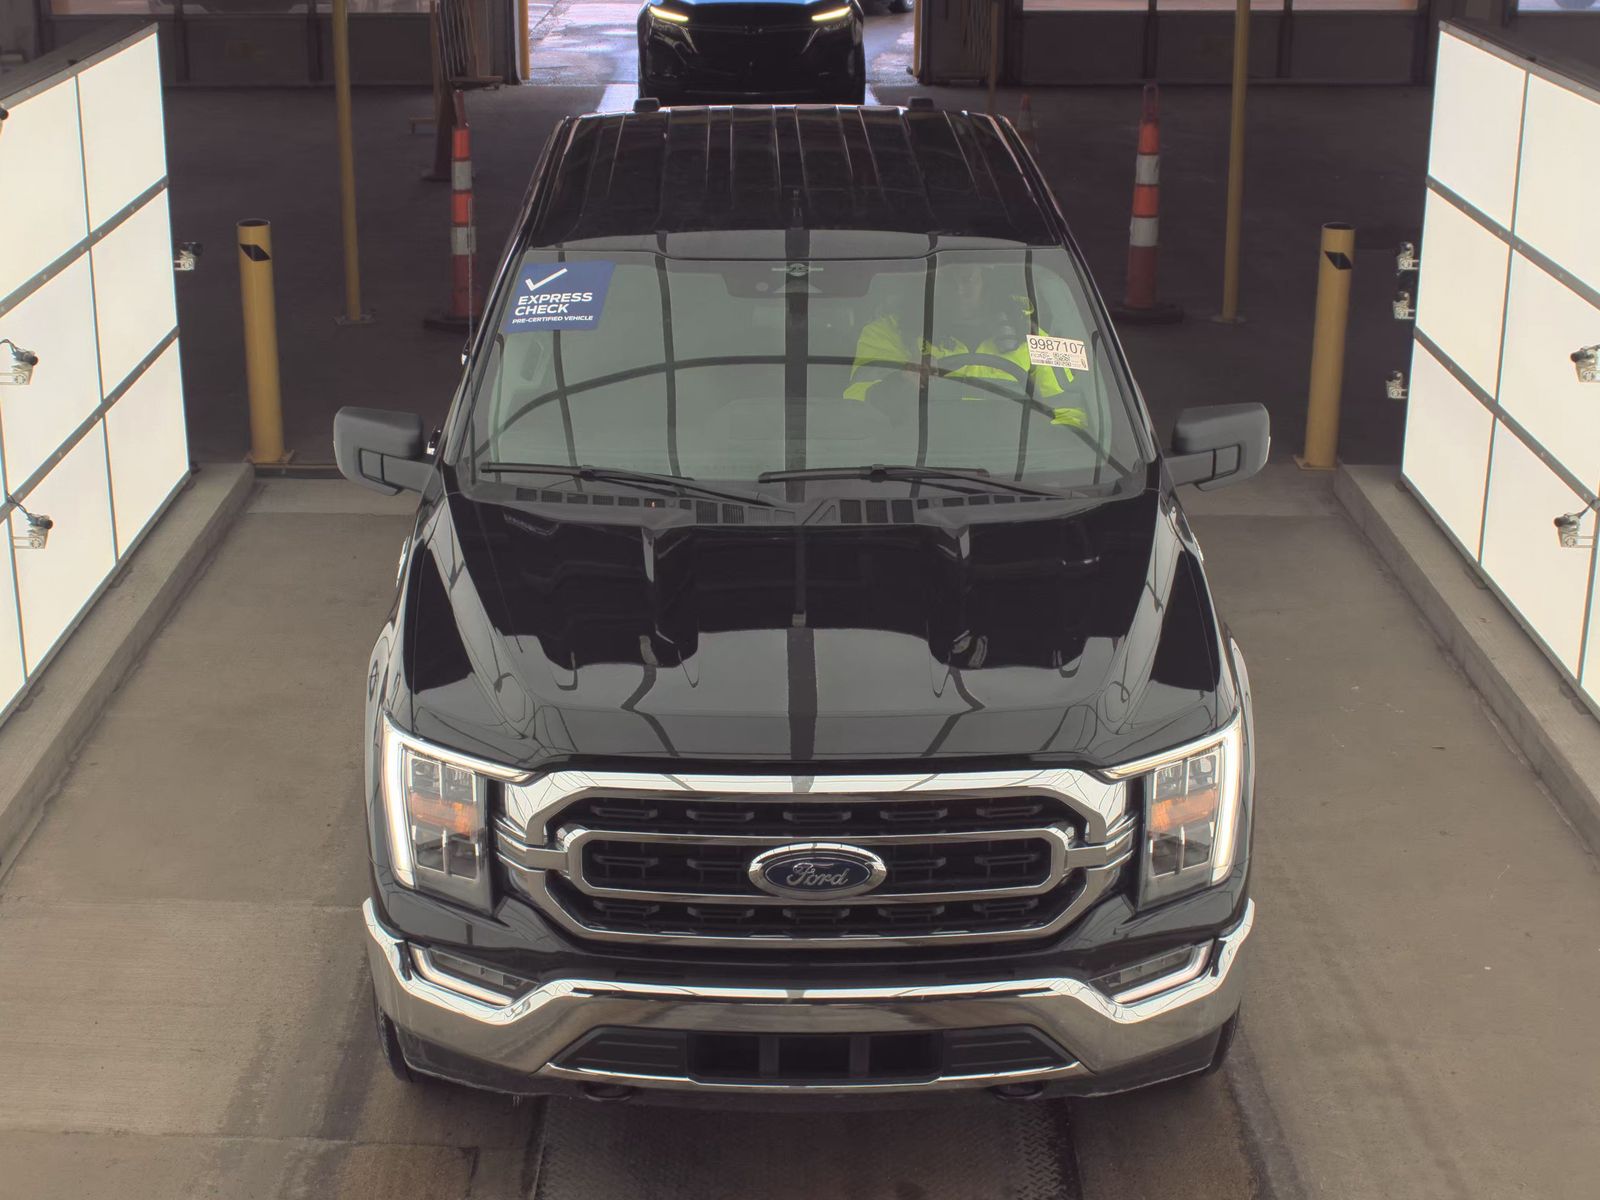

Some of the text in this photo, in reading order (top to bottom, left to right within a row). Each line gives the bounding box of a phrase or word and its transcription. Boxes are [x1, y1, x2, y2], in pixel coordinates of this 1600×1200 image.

[517, 292, 593, 306] EXPRESS
[514, 303, 570, 316] CHECK
[512, 316, 563, 325] PRE-CERTIFIED
[1029, 337, 1086, 355] 9987107
[786, 862, 850, 886] Ford
